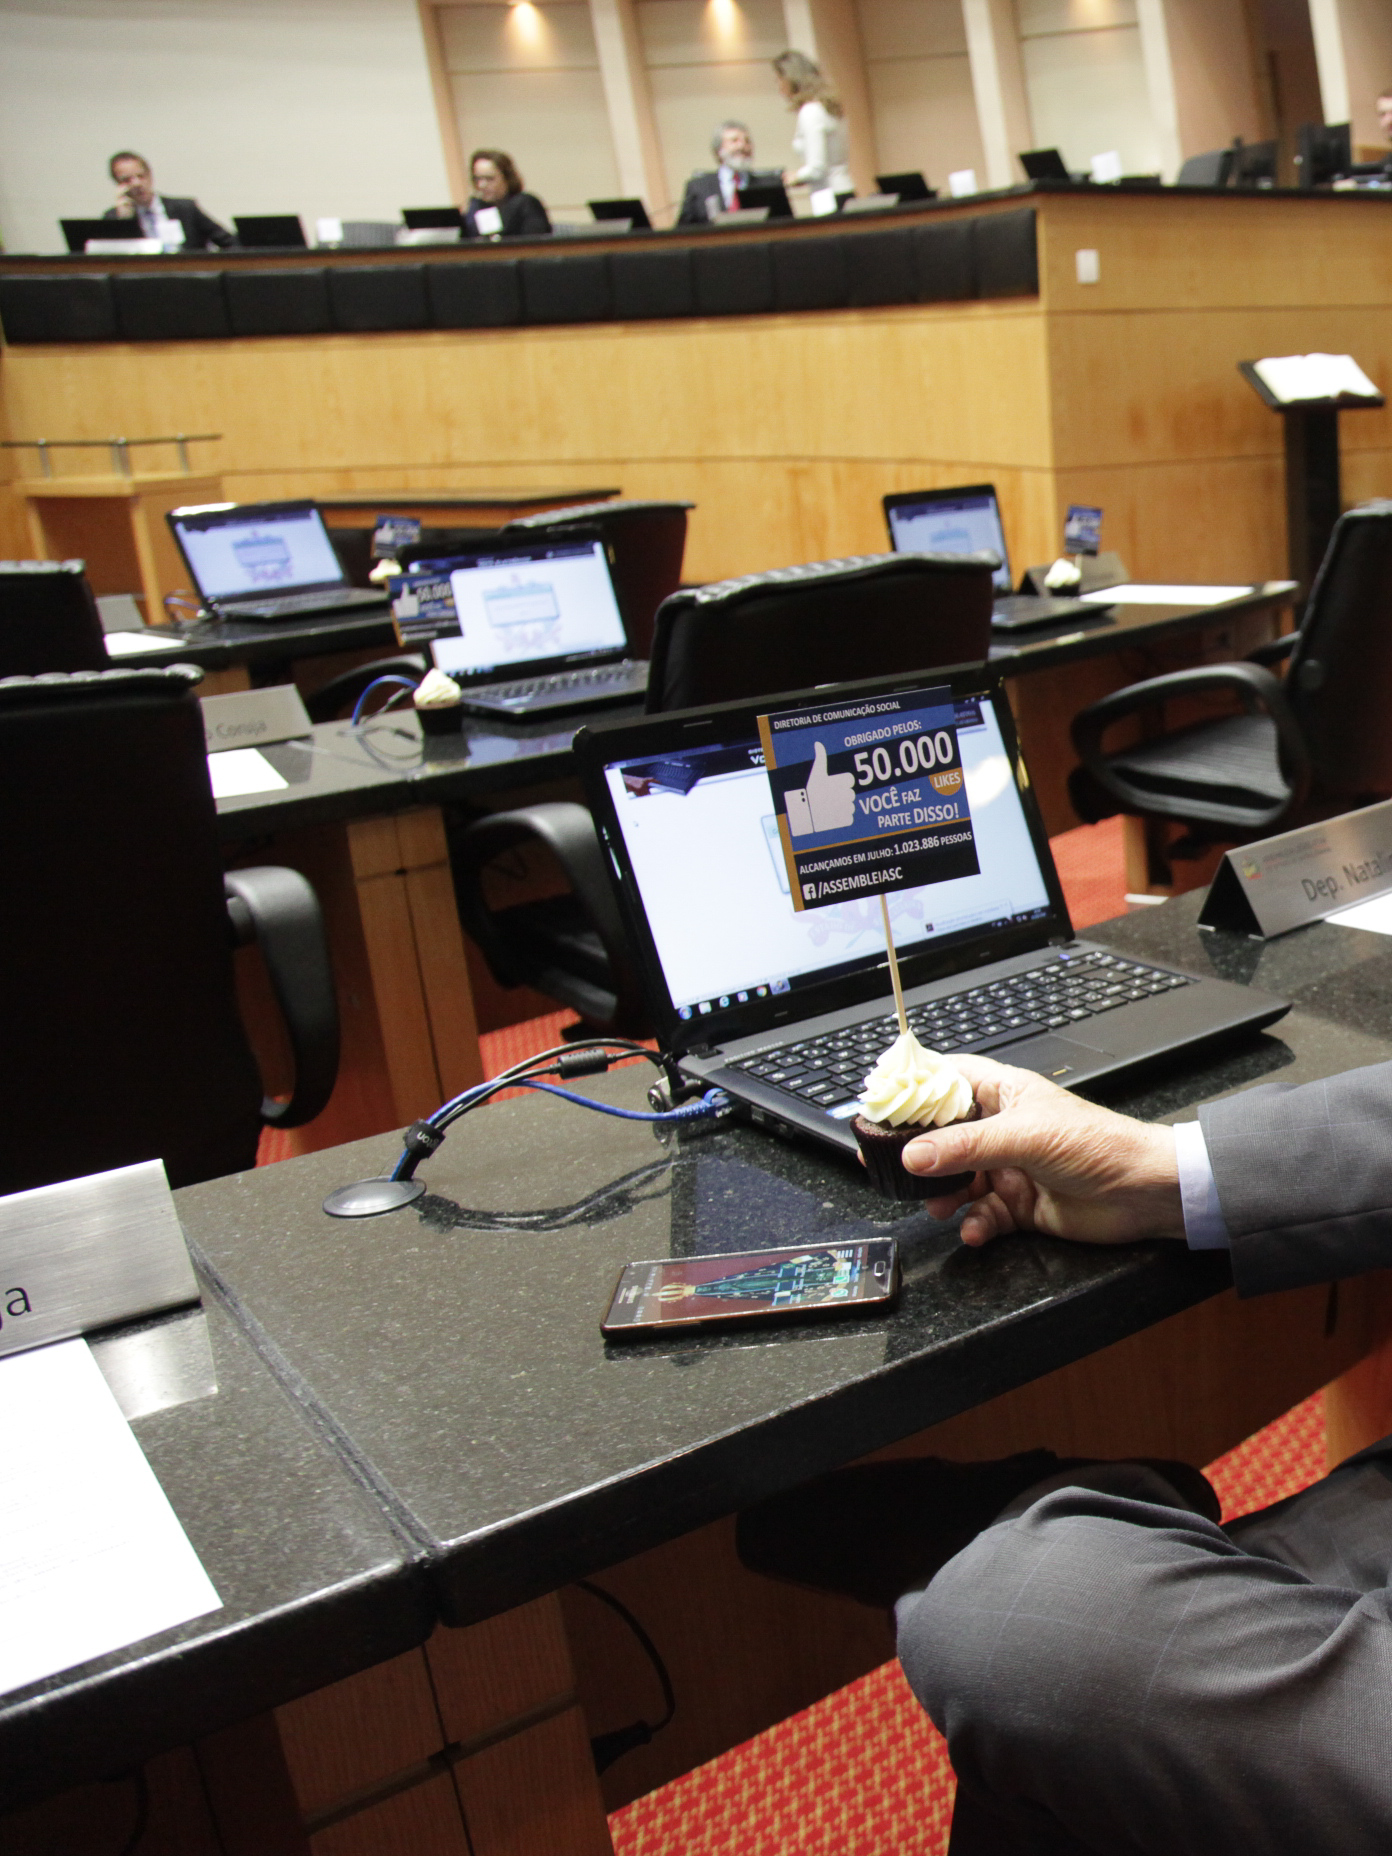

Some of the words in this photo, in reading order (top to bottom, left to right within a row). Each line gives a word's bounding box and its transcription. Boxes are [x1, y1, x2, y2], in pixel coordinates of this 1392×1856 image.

[774, 716, 812, 730] DIRETORIA
[812, 714, 823, 723] DE
[823, 704, 875, 721] COMUNICAÇÃO
[876, 701, 901, 712] SOCIAL
[844, 727, 892, 747] OBRIGADO
[892, 720, 922, 735] PELOS:
[854, 731, 953, 786] 50.000
[934, 772, 961, 788] LIKES
[858, 786, 901, 815] VOCÊ
[901, 789, 922, 805] FAZ
[877, 812, 912, 828] PARTE
[913, 802, 959, 824] DISSO!
[799, 855, 853, 875] ALCANÇAMOS
[853, 852, 867, 864] EM
[867, 849, 894, 862] JULHO:
[894, 836, 940, 855] 1.023.886
[940, 831, 973, 846] PESSOAS
[818, 867, 904, 899] /ASSEMBLEIASC
[1301, 876, 1344, 902] Dep.
